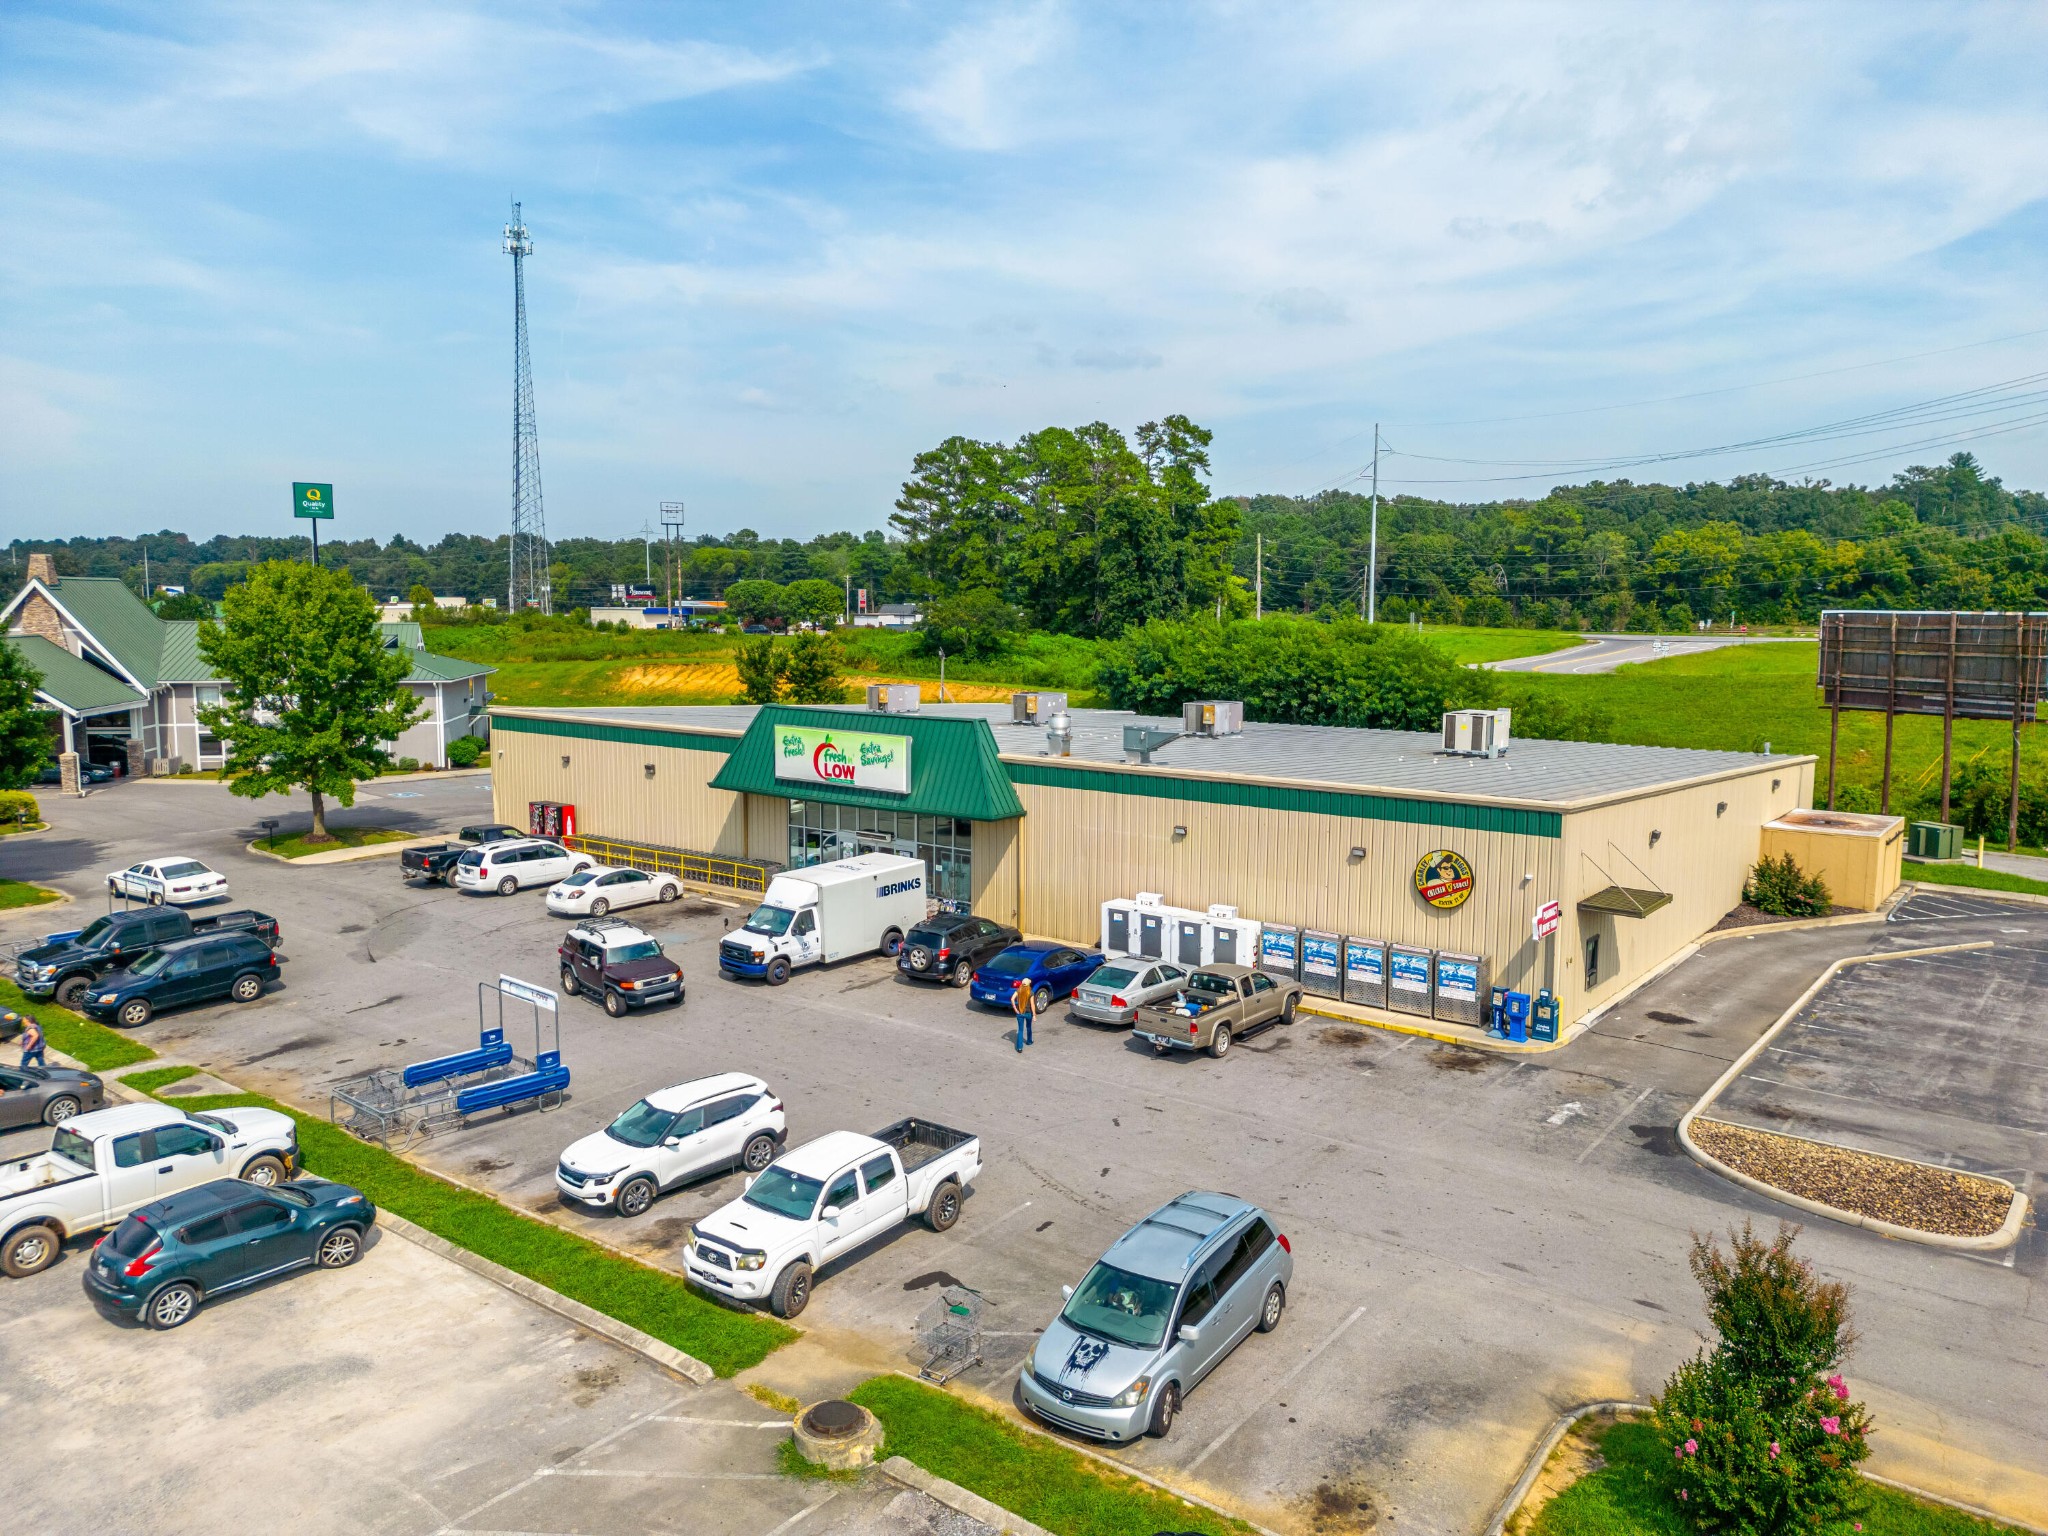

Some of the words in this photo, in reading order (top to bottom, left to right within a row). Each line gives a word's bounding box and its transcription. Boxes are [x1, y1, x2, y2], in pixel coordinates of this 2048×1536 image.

[302, 500, 326, 508] Quality
[860, 741, 882, 754] Extra
[824, 763, 855, 779] LOW
[883, 878, 921, 897] BRINKS
